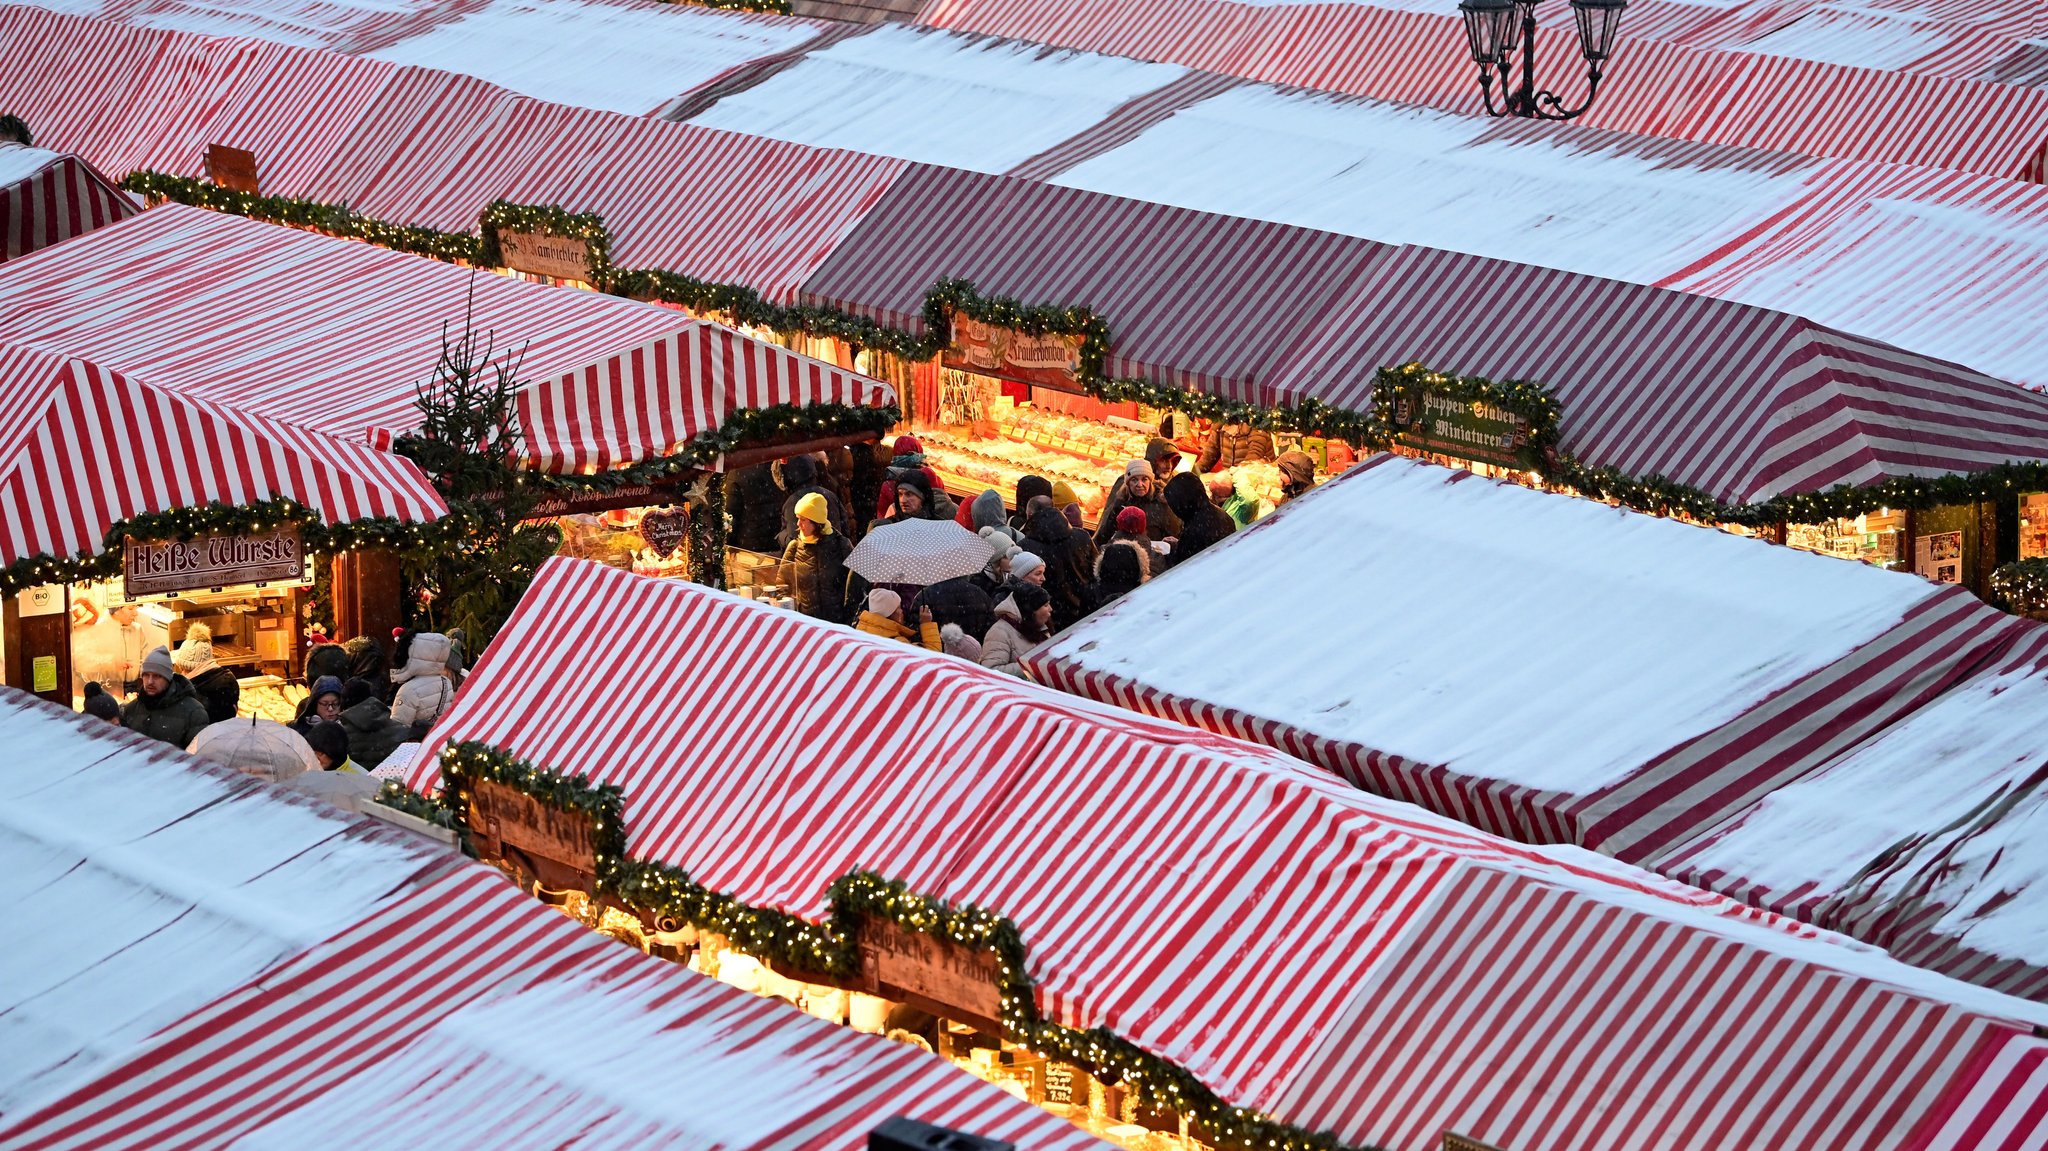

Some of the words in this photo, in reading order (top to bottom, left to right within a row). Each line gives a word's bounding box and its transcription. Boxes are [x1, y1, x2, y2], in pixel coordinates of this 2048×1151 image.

[1007, 338, 1066, 362] Kräuterbonbon
[1422, 390, 1466, 417] Puppen
[1473, 400, 1516, 425] Stuben
[1435, 419, 1501, 447] Miniaturen
[652, 530, 683, 540] Christmas
[132, 541, 200, 577] Heiße
[208, 532, 296, 568] Würste
[289, 565, 299, 574] 86
